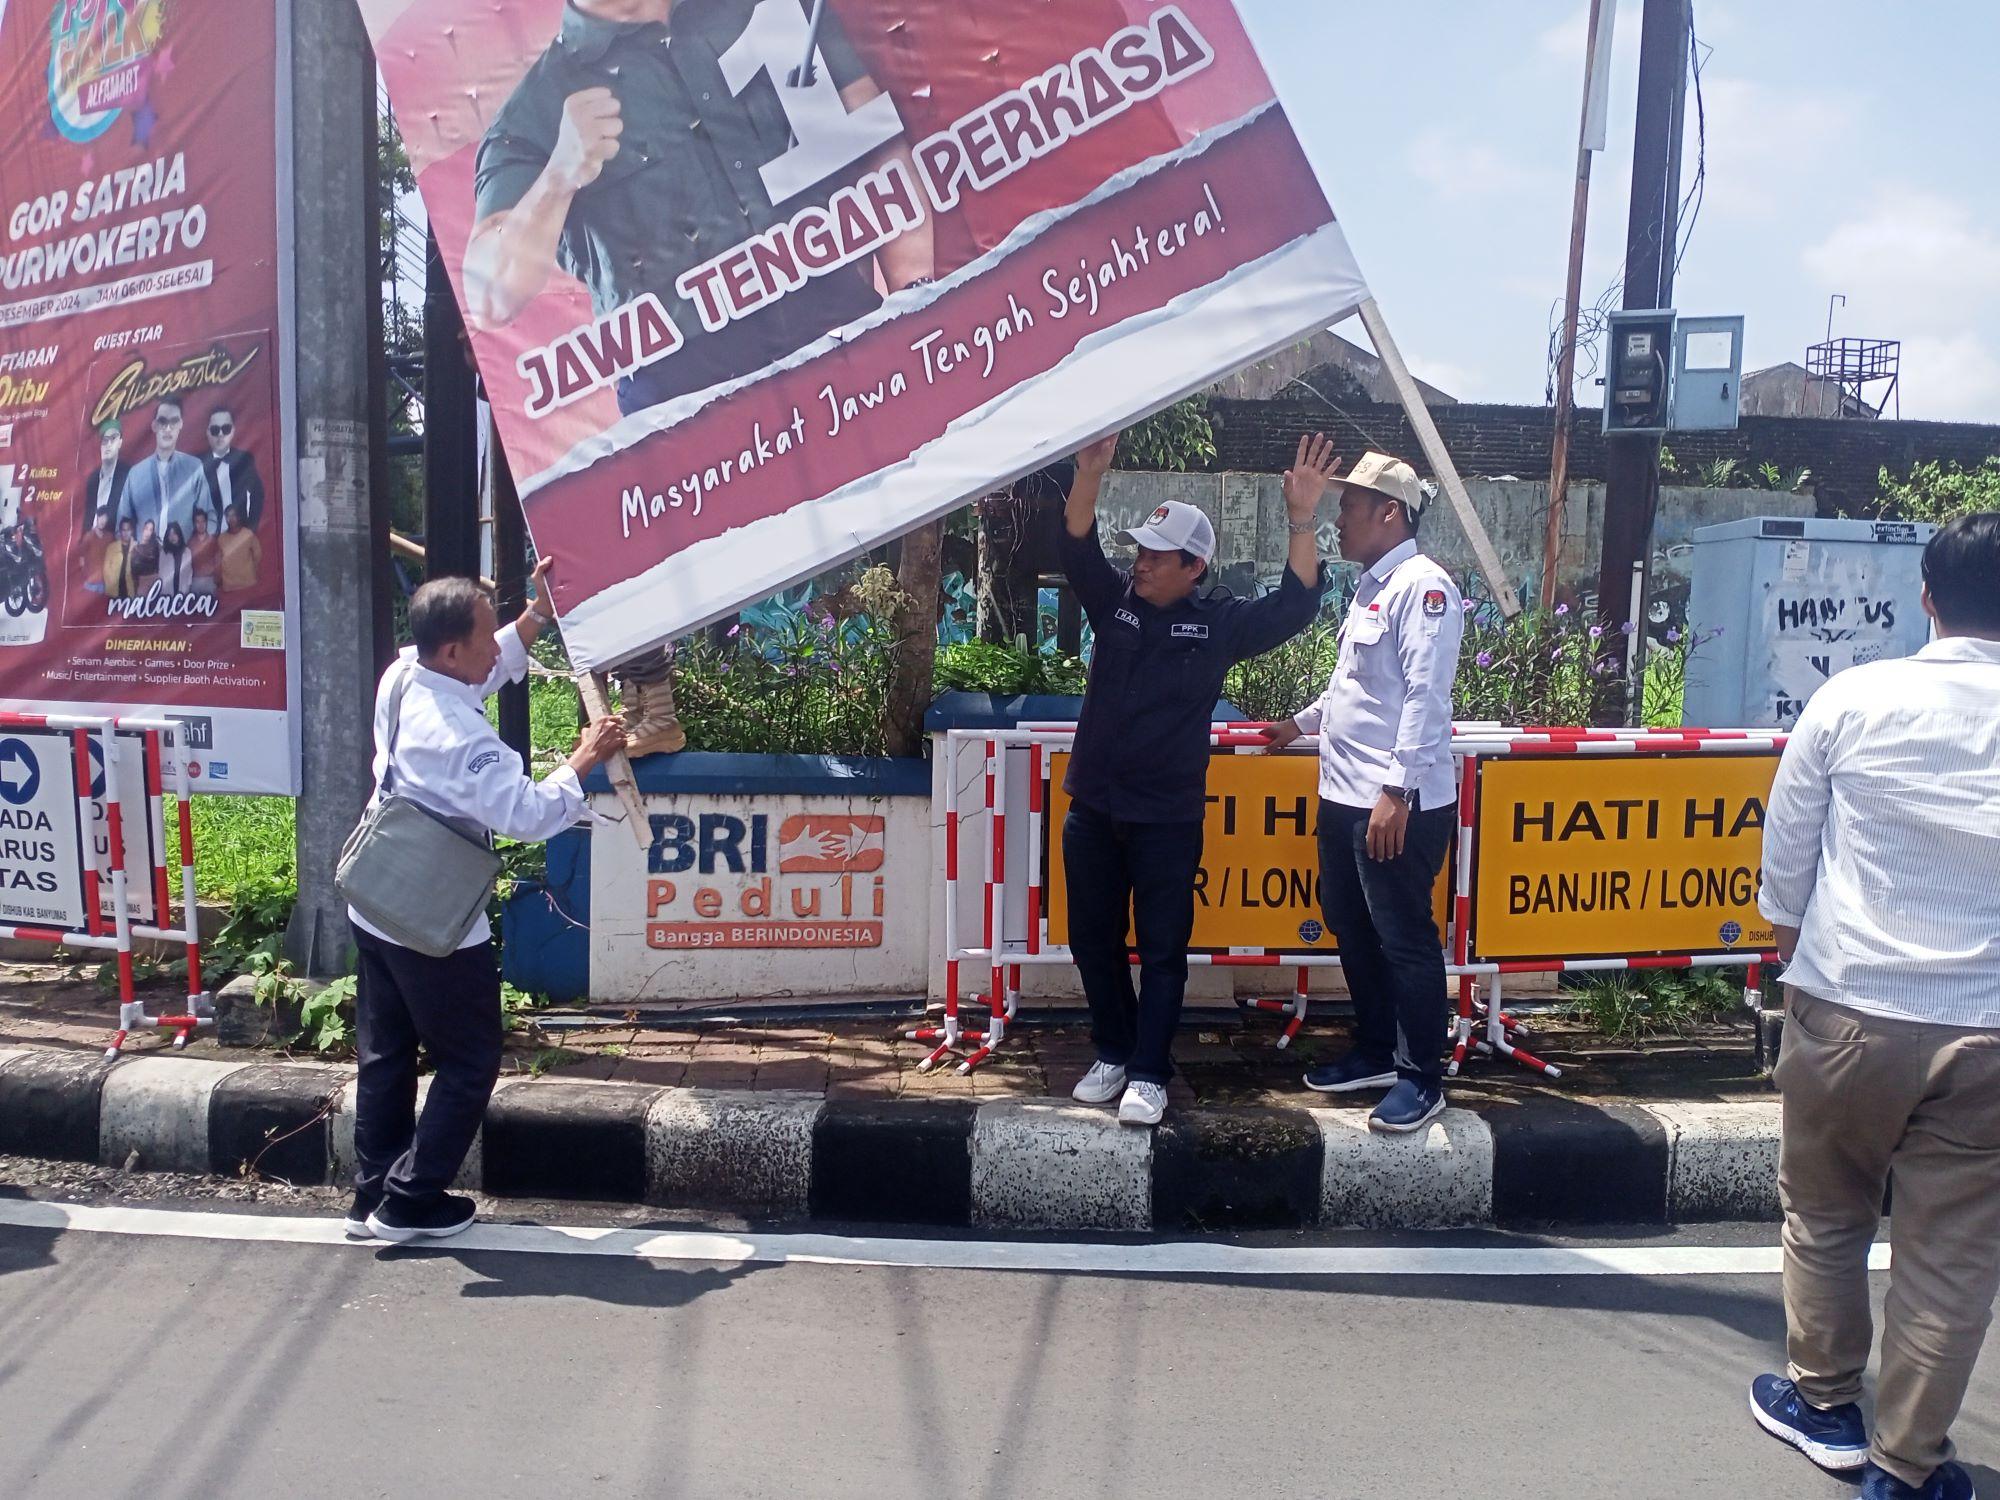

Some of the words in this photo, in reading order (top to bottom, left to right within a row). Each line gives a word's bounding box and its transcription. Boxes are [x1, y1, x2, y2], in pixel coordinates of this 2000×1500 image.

[86, 65, 140, 109] ALFAMART
[9, 190, 68, 241] GOR
[71, 151, 186, 222] SATRIA
[518, 296, 682, 416] JAWA
[678, 162, 922, 329] TENGAH
[915, 8, 1211, 208] PERKASA
[55, 293, 81, 312] 2024
[96, 286, 119, 304] JAM
[93, 330, 132, 351] GUEST
[132, 324, 164, 345] STAR
[620, 406, 805, 538] Masyarakat
[818, 371, 907, 437] Jawa
[910, 294, 1034, 385] Tengah
[1041, 182, 1227, 319] Sejahtera!
[18, 464, 29, 480] 2
[29, 467, 58, 478] Kulkas
[25, 485, 36, 502] 2
[36, 490, 63, 501] Motor
[107, 579, 219, 619] malacca
[105, 639, 187, 652] DIMERIAHKAN
[72, 657, 102, 666] Senam
[104, 657, 137, 667] Aerobic
[145, 658, 175, 668] Games
[183, 659, 206, 669] Door
[207, 660, 230, 670] Prize
[75, 671, 137, 682] Entertainment
[144, 673, 183, 686] Supplier
[183, 674, 211, 685] Booth
[213, 676, 260, 687] Activation
[1512, 799, 1660, 843] HATI
[0, 839, 56, 863] RUS
[647, 813, 769, 874] BRI
[646, 875, 885, 919] Peduli
[1508, 871, 1631, 915] BANJIR
[654, 929, 725, 946] Bangga
[731, 926, 875, 943] BERINDONESIA
[1748, 930, 1774, 942] DISHUB
